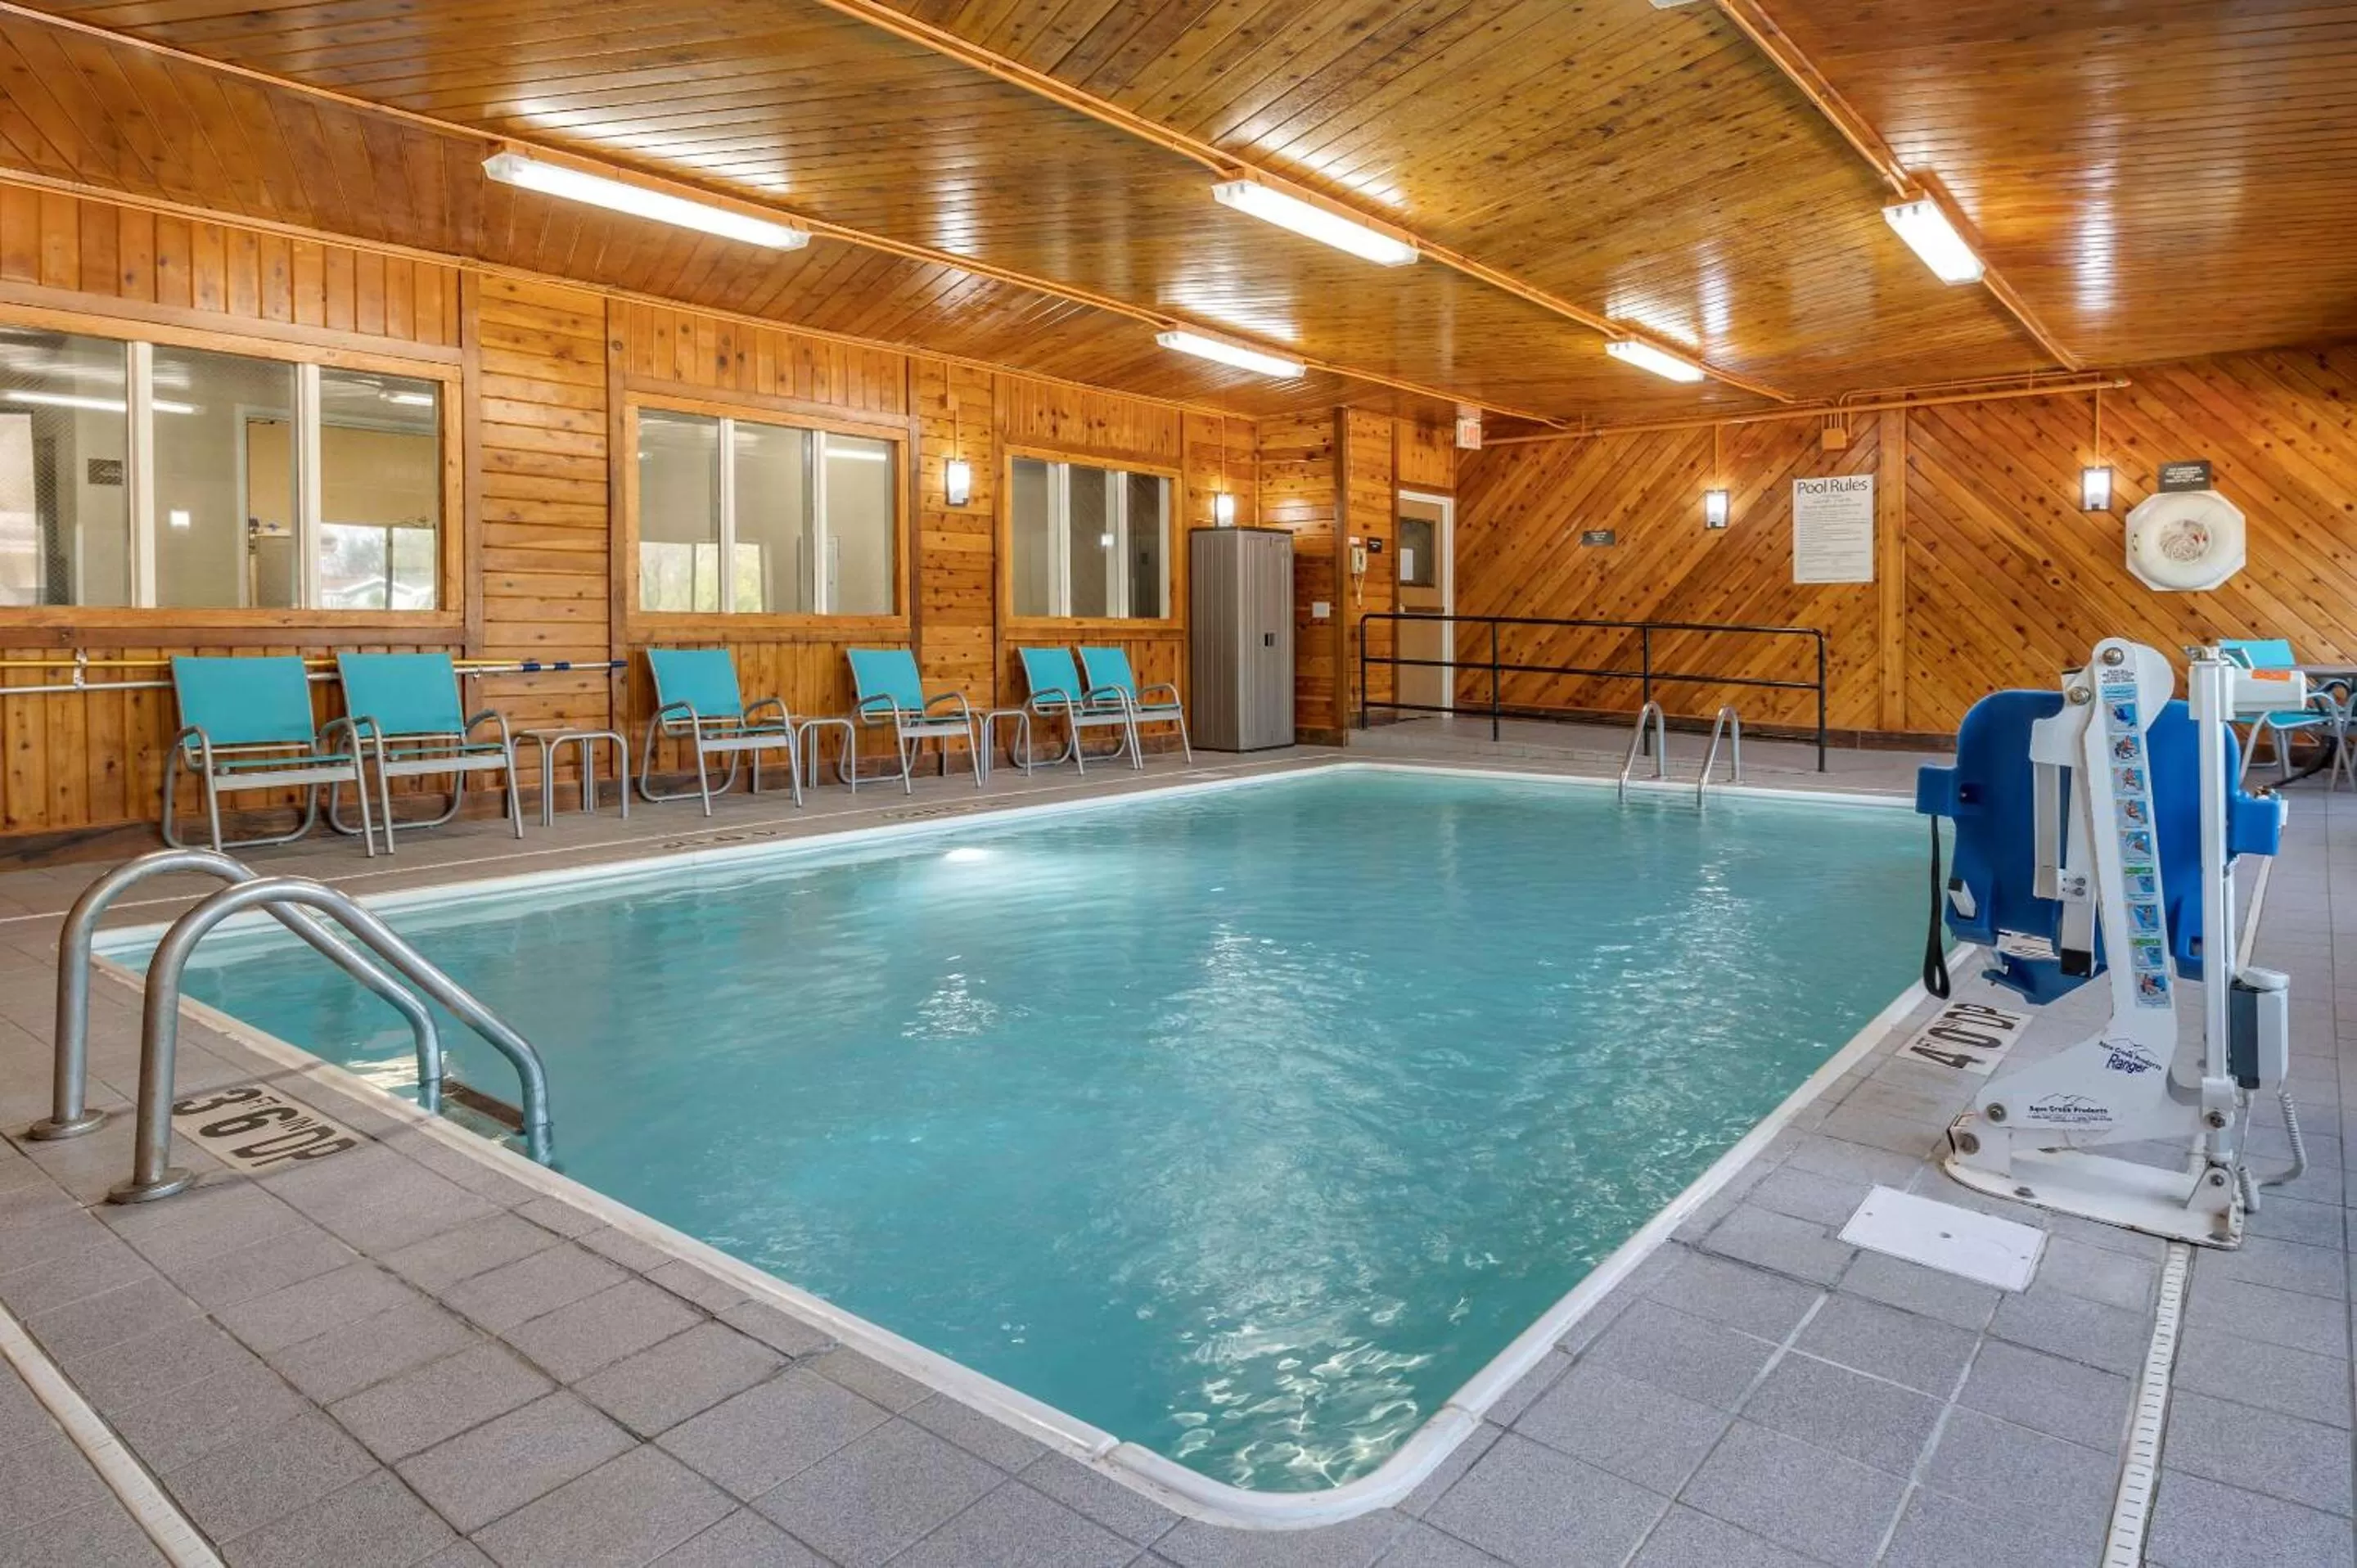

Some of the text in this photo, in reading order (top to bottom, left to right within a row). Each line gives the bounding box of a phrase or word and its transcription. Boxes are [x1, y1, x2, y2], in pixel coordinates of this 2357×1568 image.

[1797, 477, 1868, 494] Pool Rules
[2105, 1053, 2148, 1074] Ranger
